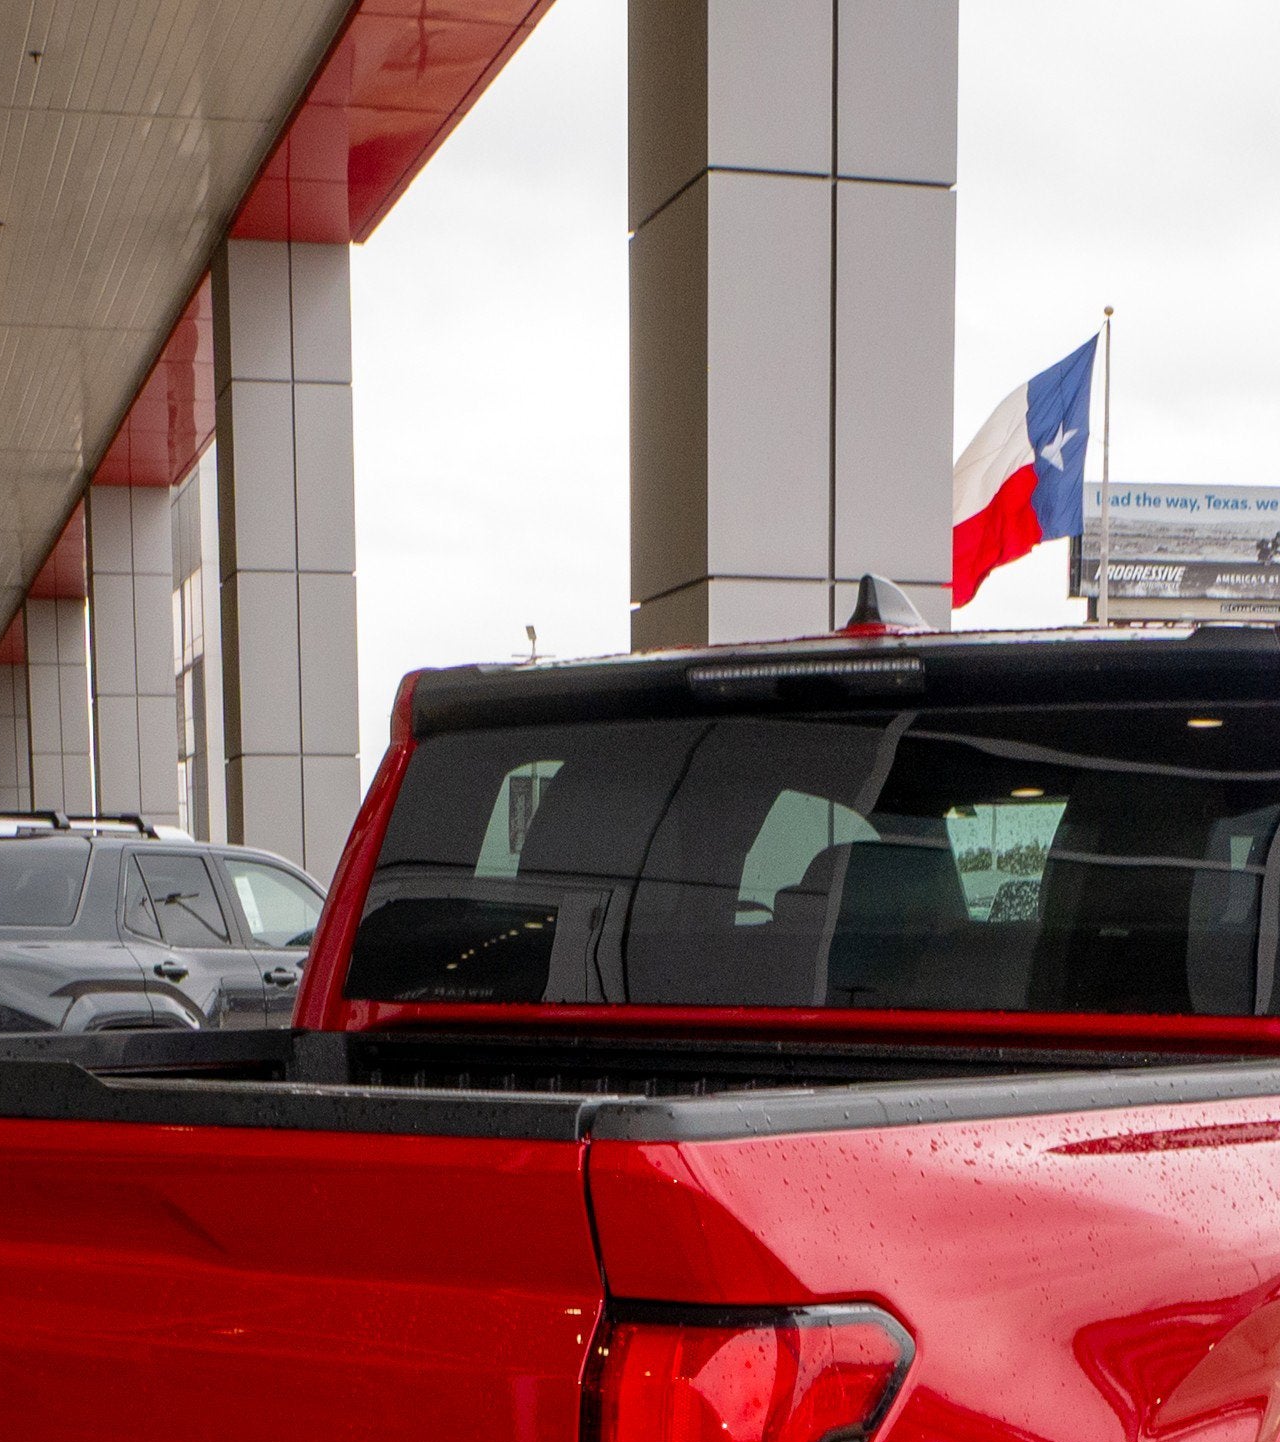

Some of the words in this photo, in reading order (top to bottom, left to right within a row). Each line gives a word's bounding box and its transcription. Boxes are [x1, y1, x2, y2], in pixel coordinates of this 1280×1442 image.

[1096, 491, 1131, 507] lad
[1135, 492, 1161, 507] the
[1165, 497, 1200, 513] way,
[1205, 494, 1252, 511] Texas.
[1215, 574, 1266, 585] AMERICA'S
